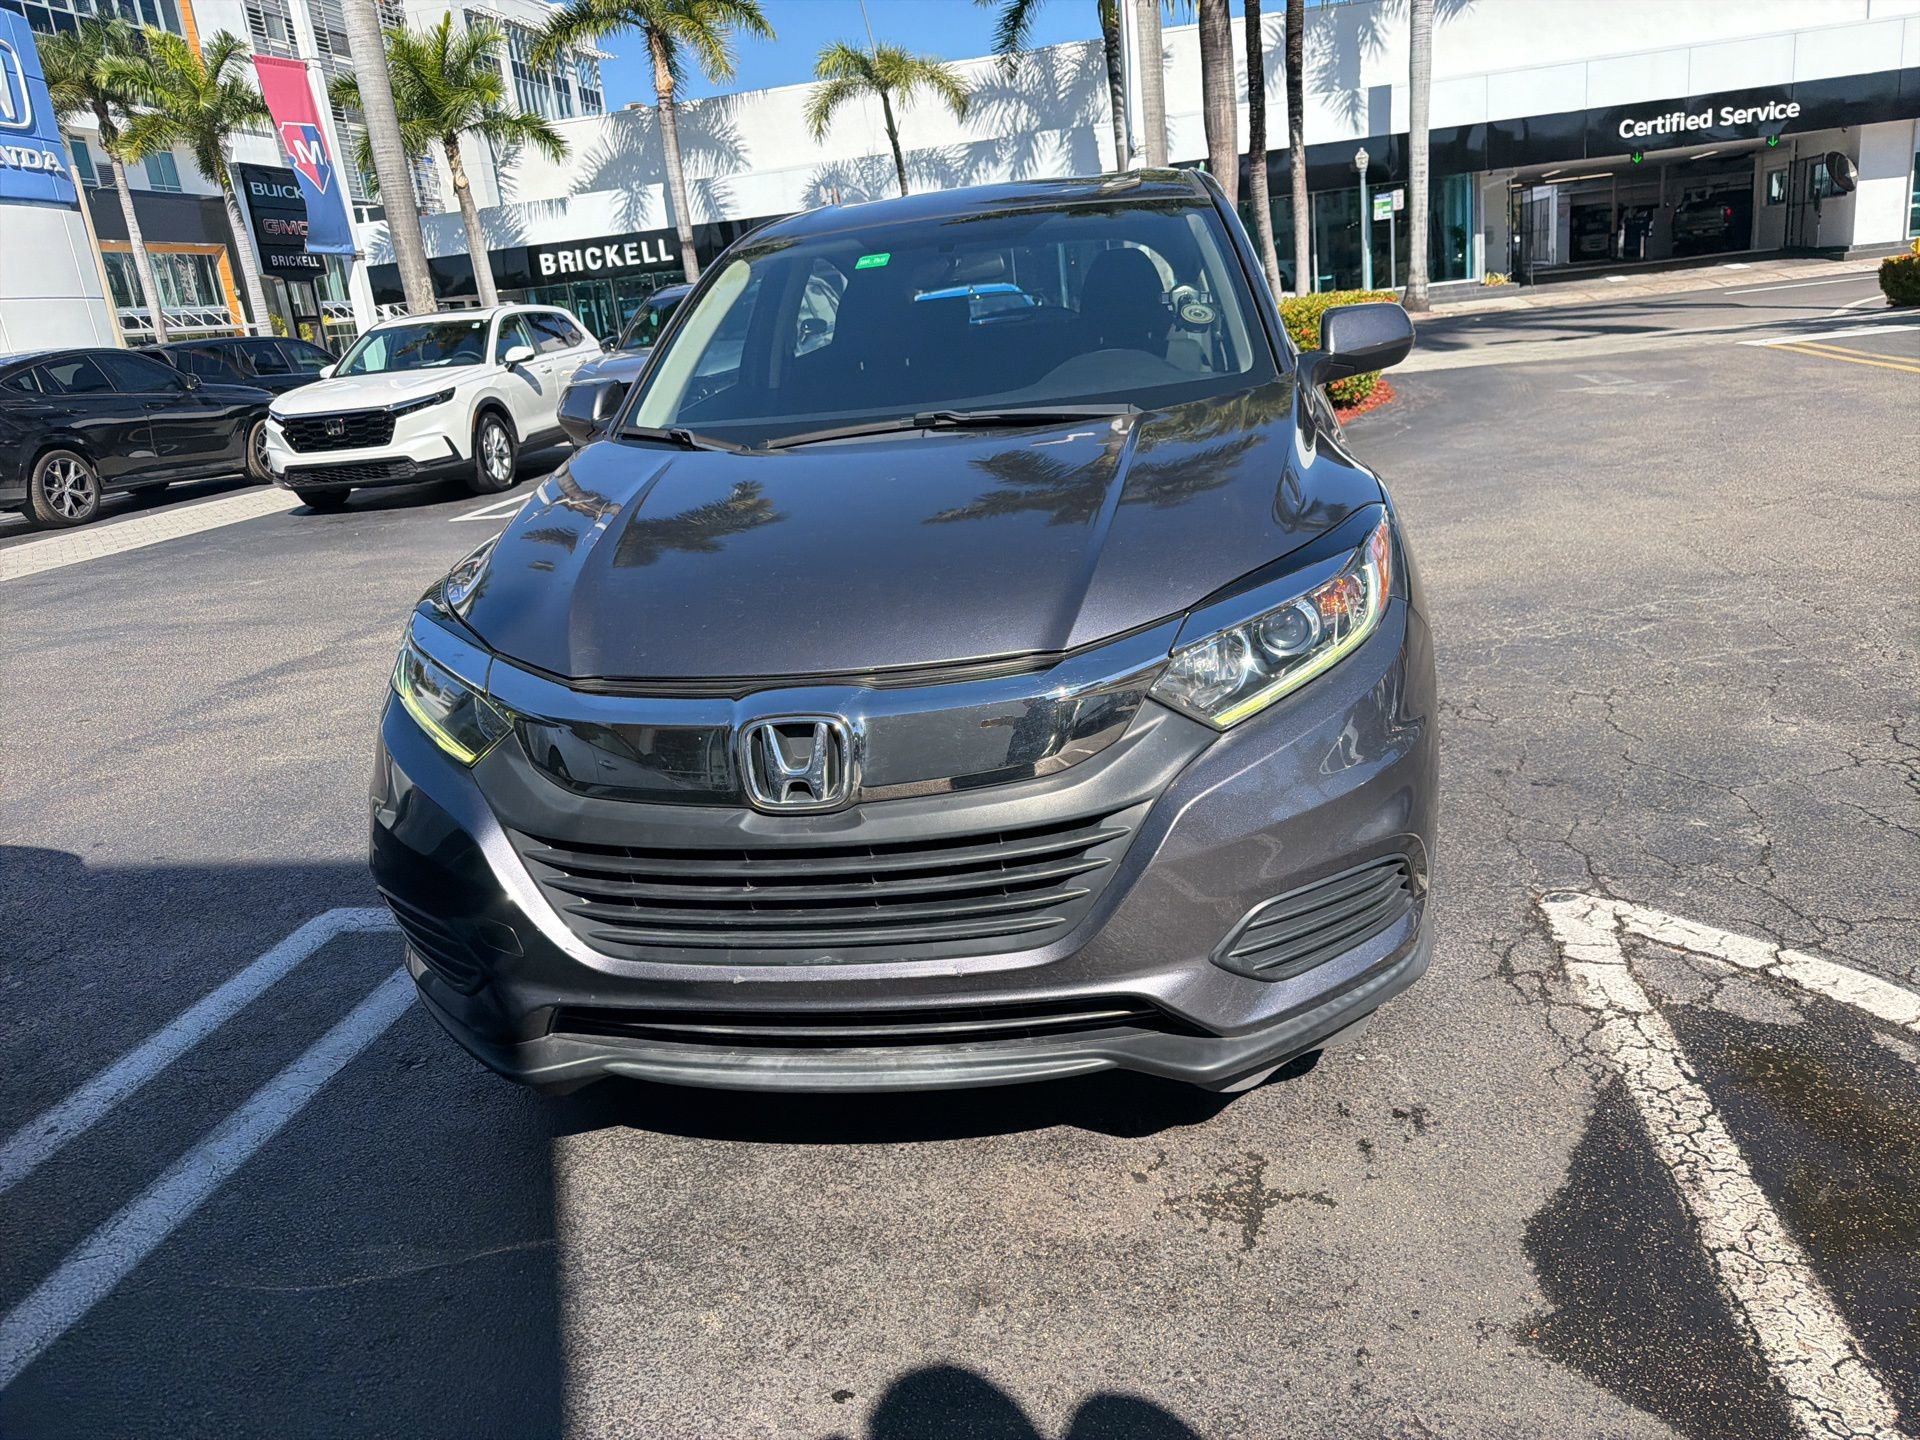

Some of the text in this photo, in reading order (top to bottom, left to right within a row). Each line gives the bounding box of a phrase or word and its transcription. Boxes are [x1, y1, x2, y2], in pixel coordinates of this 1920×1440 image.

[1618, 100, 1801, 139] Certified Service
[292, 139, 325, 165] M
[250, 181, 306, 199] BUICK
[262, 218, 308, 235] GMC
[270, 254, 321, 268] BRICKELL
[538, 238, 675, 276] BRICKELL
